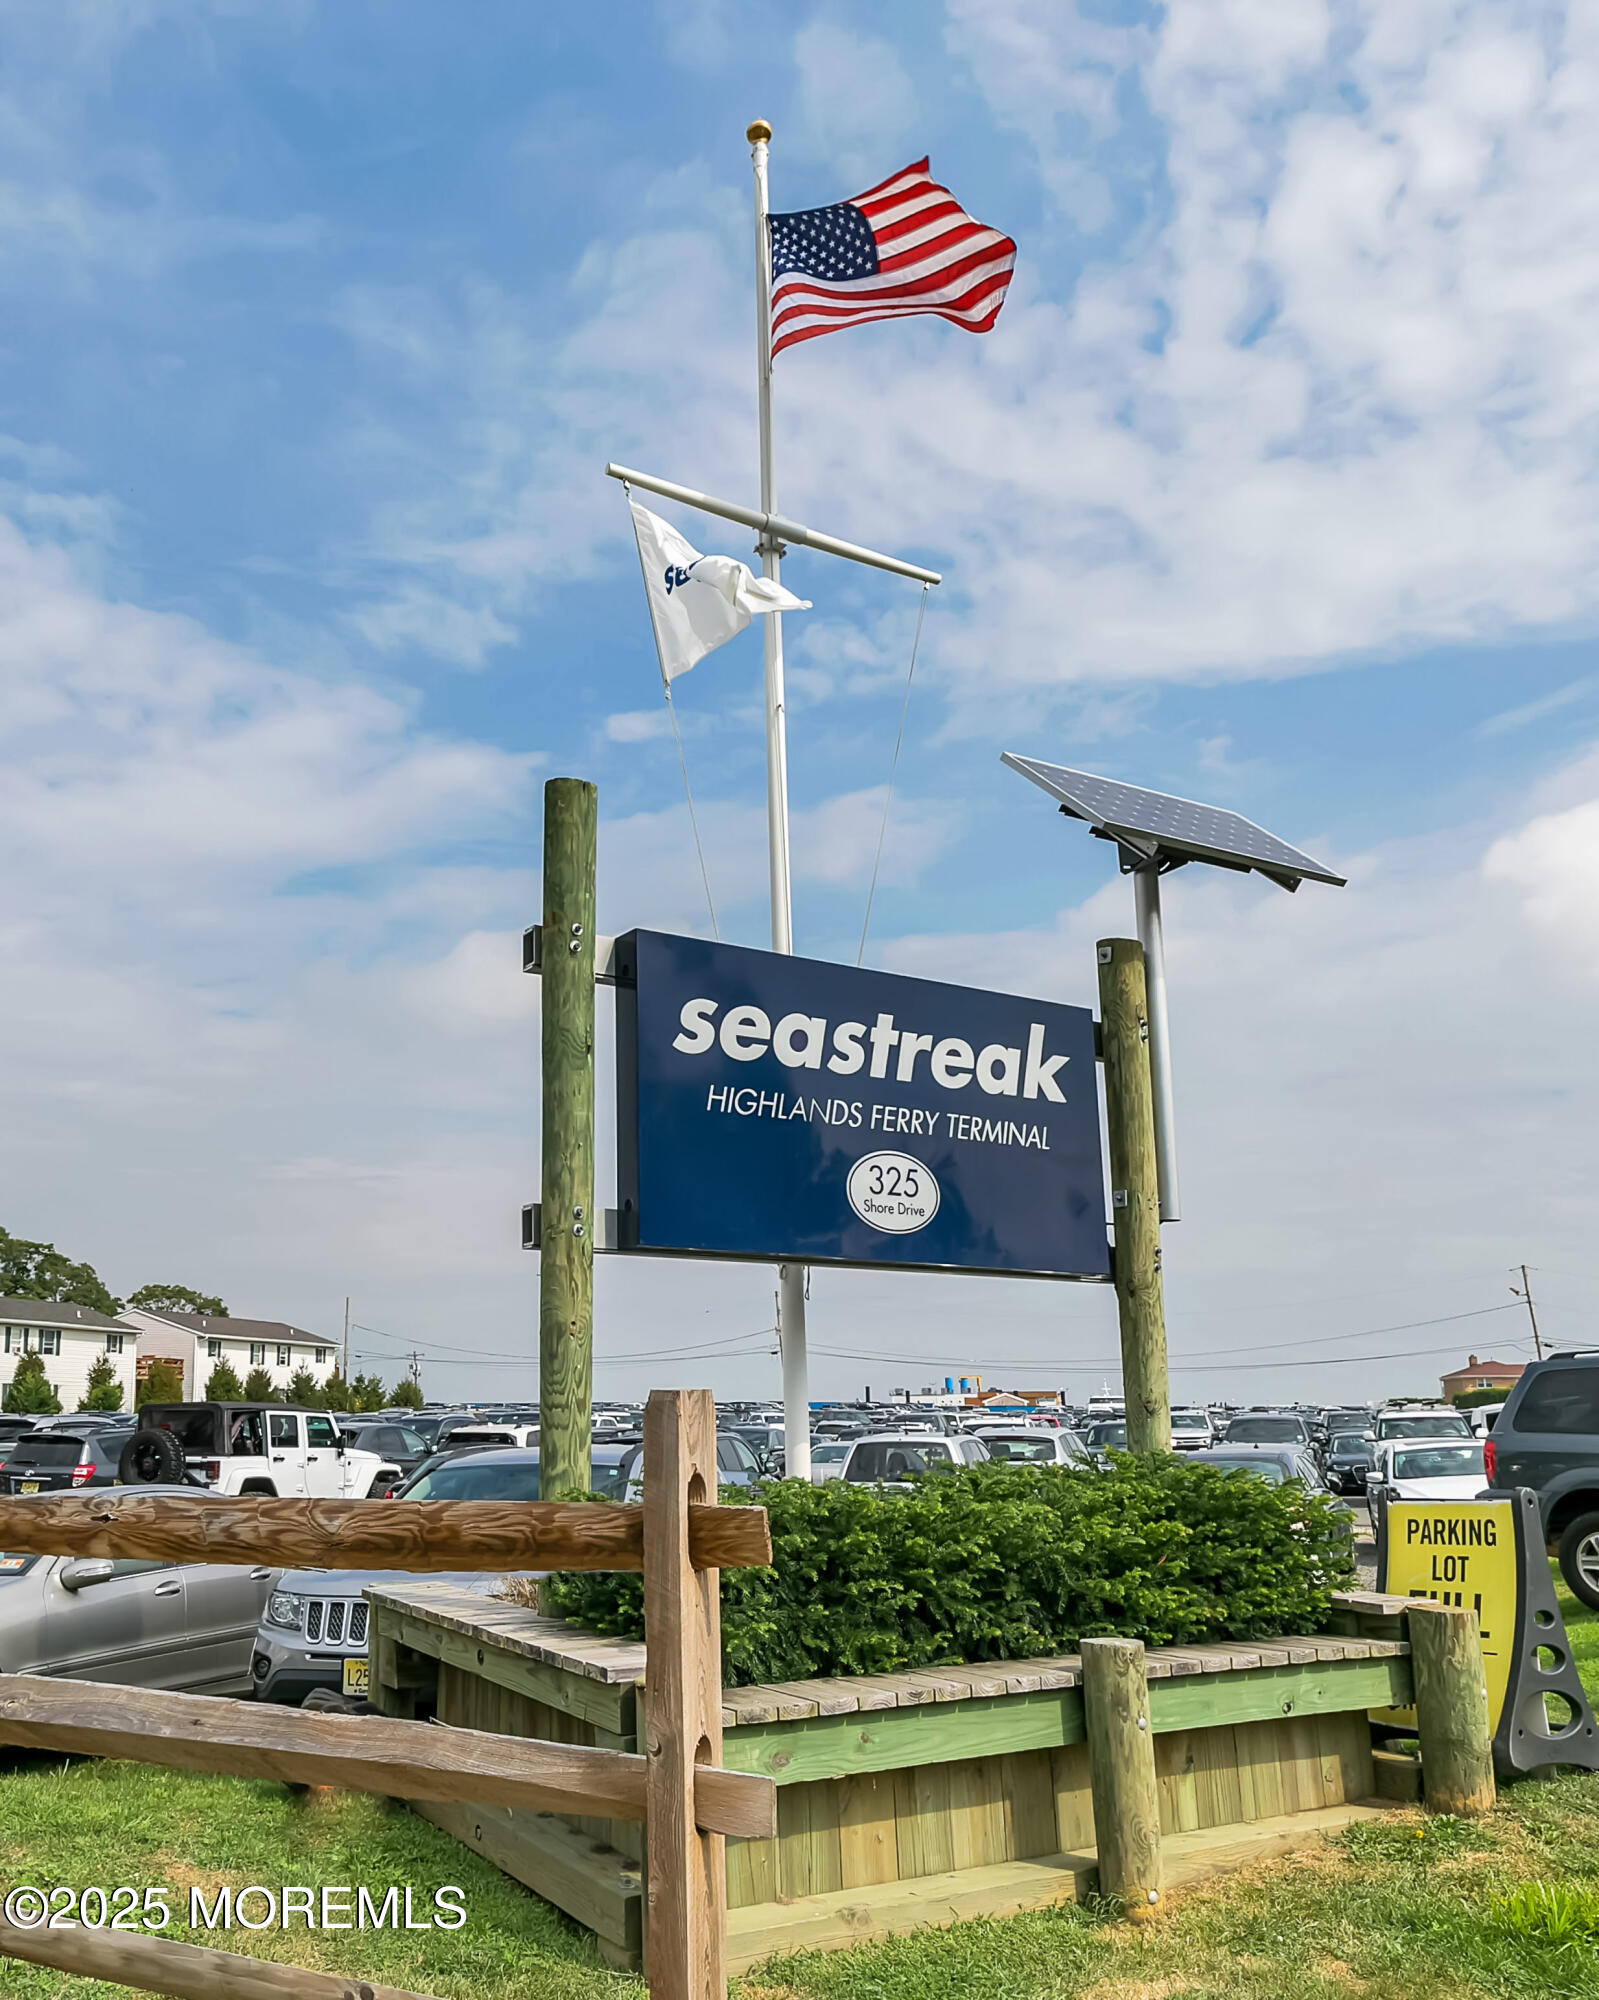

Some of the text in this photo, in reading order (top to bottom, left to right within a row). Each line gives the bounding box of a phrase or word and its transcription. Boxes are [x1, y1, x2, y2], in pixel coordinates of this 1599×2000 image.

[672, 998, 1071, 1104] seastreak
[706, 1084, 1051, 1150] HIGHLANDS FERRY TERMINAL
[868, 1164, 919, 1198] 325
[863, 1199, 925, 1217] Shore Drive
[1407, 1518, 1497, 1547] PARKING
[1431, 1554, 1470, 1583] LOT
